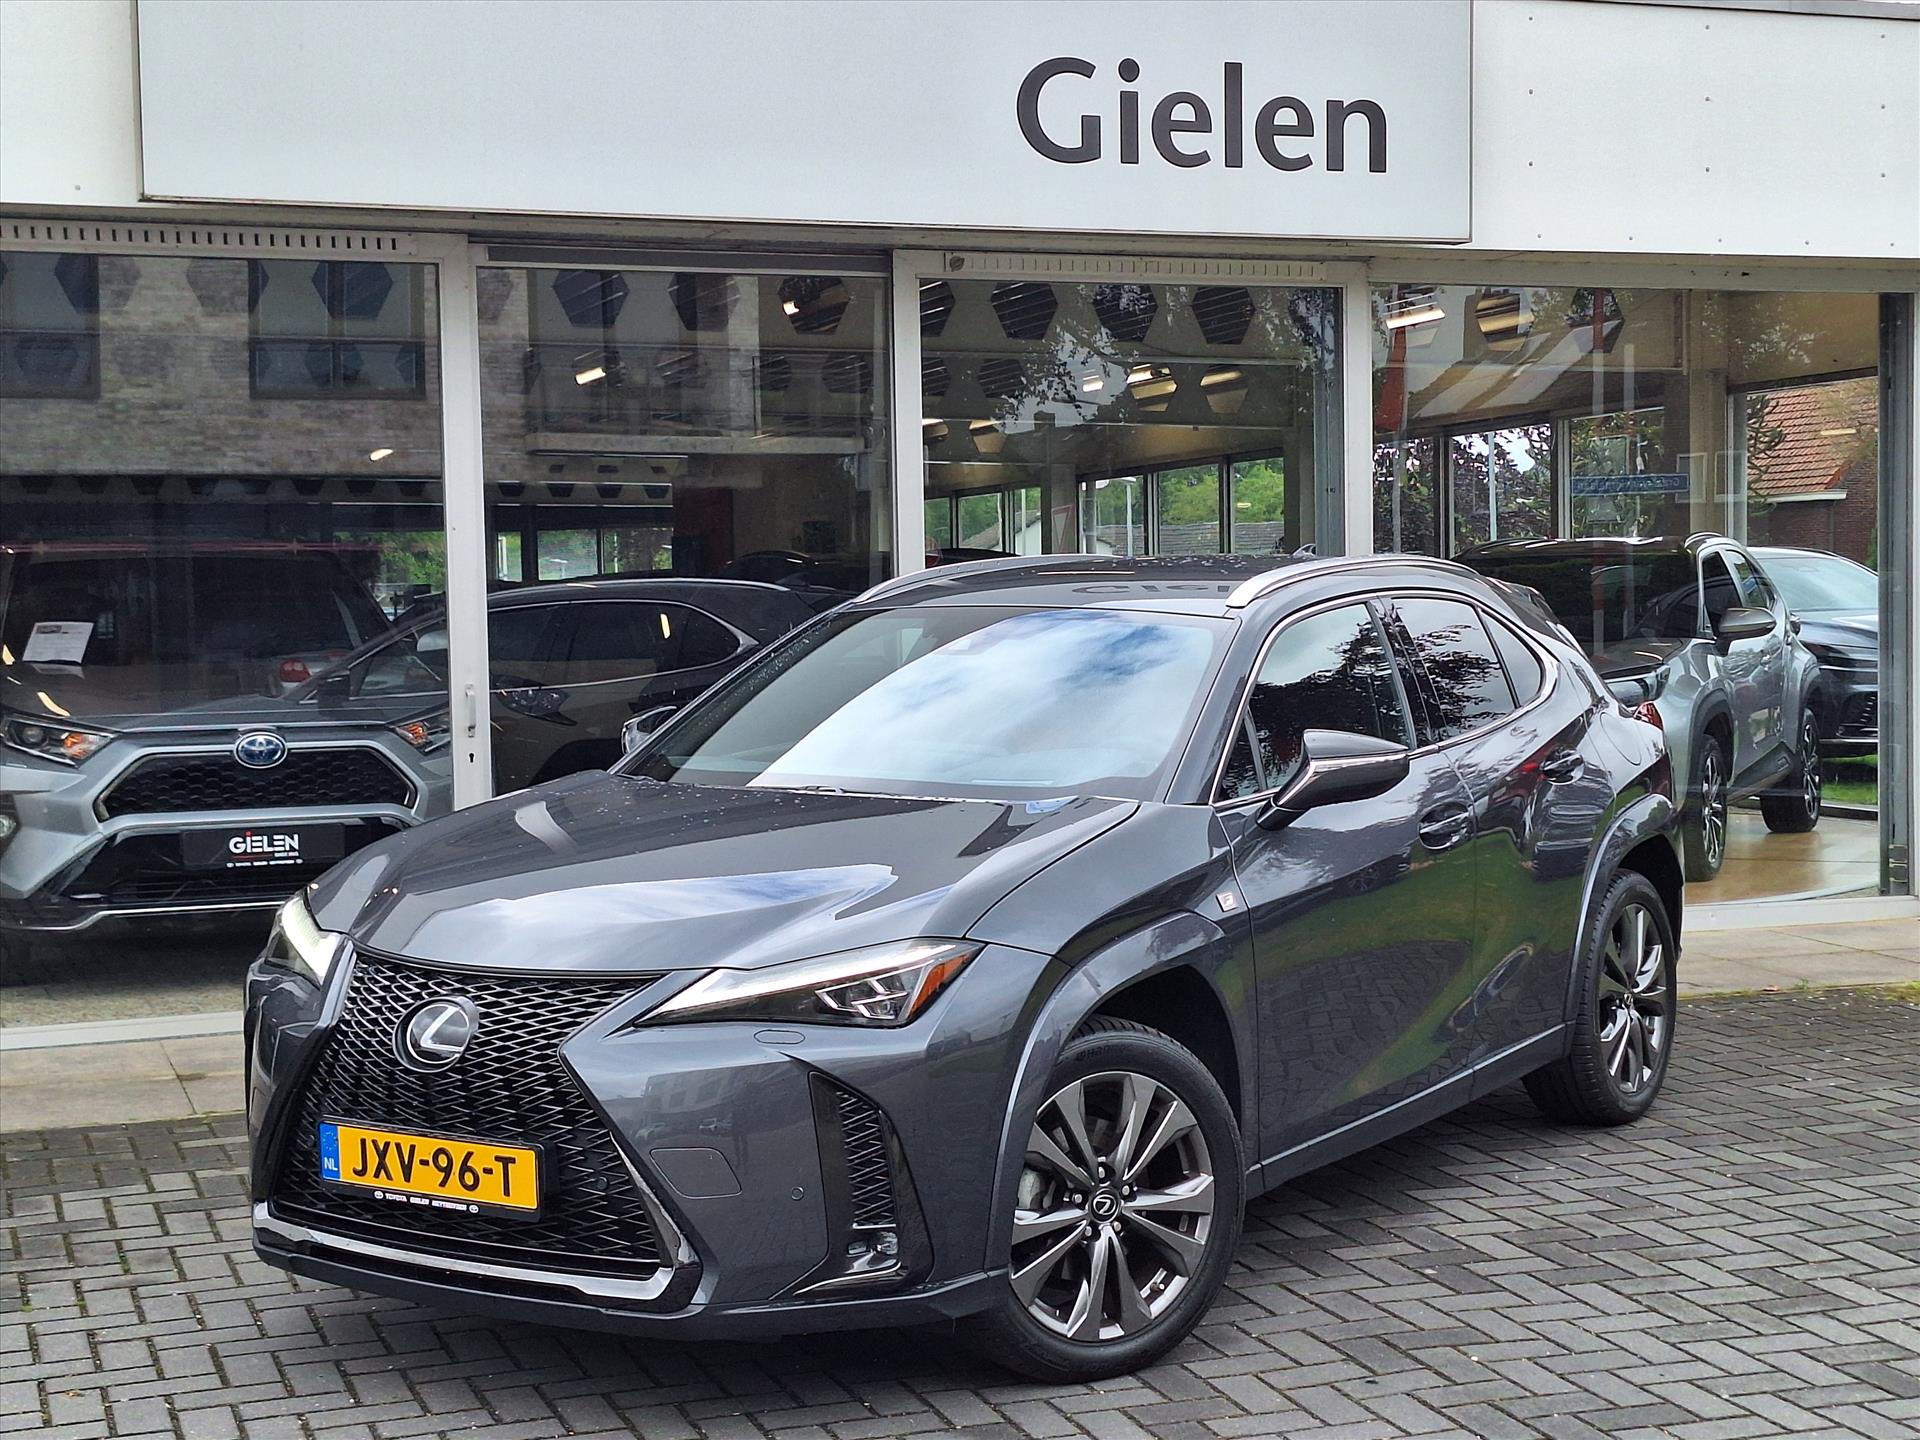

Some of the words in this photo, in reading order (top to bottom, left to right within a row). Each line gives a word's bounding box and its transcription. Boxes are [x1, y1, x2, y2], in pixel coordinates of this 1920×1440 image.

[1016, 56, 1387, 173] Gielen
[324, 1156, 338, 1170] NL
[352, 1137, 516, 1197] JXV-96-T
